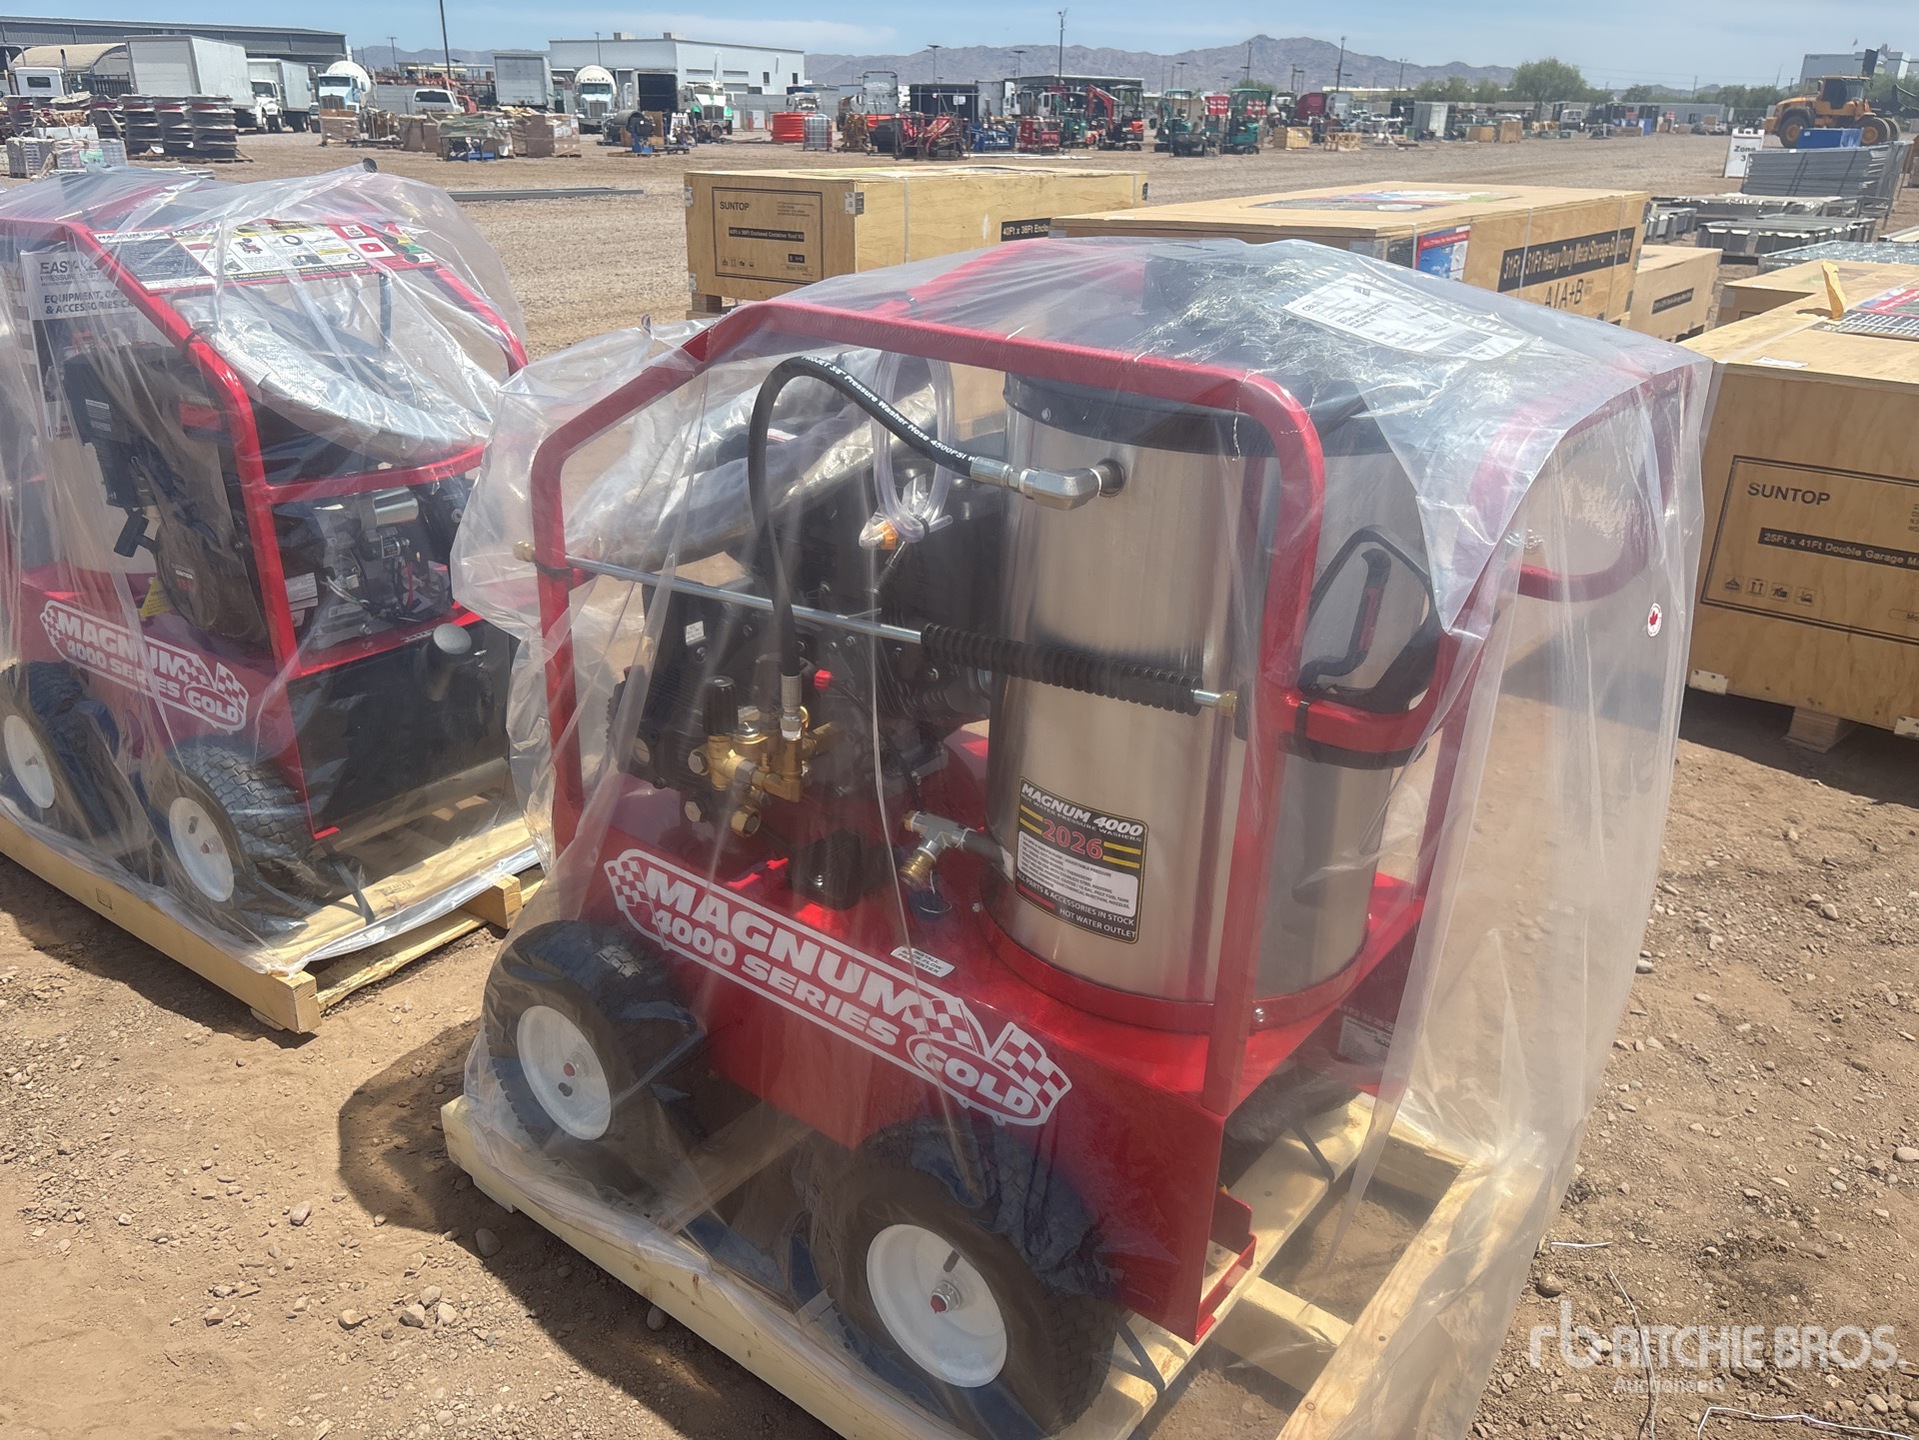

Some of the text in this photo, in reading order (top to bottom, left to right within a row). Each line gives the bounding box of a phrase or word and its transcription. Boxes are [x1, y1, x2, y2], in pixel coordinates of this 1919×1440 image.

[719, 201, 749, 211] SUNTOP
[1542, 249, 1559, 274] Heavy
[1560, 246, 1574, 271] Duty
[1574, 243, 1588, 263] Metal
[1588, 240, 1610, 263] Storage
[46, 305, 54, 314] &
[55, 300, 119, 314] ACCESSORIES
[844, 373, 878, 402] Pressure
[878, 400, 908, 426] Washer
[907, 423, 930, 442] Hose
[929, 439, 967, 461] 4500PSI
[1747, 483, 1830, 505] SUNTOP
[1763, 532, 1787, 545] 25Ft
[1799, 538, 1822, 550] 41Ft
[1825, 542, 1862, 557] Double
[1865, 550, 1904, 565] Garage
[109, 658, 180, 698] SERES
[187, 690, 239, 724] GOLD
[1021, 783, 1143, 836] MAGNUM 4000
[1033, 801, 1056, 816] WATER
[1058, 812, 1097, 830] PRESSURE
[1099, 828, 1142, 842] WASHERS
[1042, 818, 1103, 859] 2026
[1025, 878, 1043, 894] PARTS
[1050, 892, 1097, 917] ACCESSORIES
[1097, 910, 1107, 919] IN
[1107, 913, 1136, 927] STOCK
[1059, 908, 1136, 938] HOT WATER OUTLET
[644, 867, 918, 1026] MAGNUM
[651, 907, 900, 1046] 4000 SERIES
[916, 1041, 1035, 1114] GOLD
